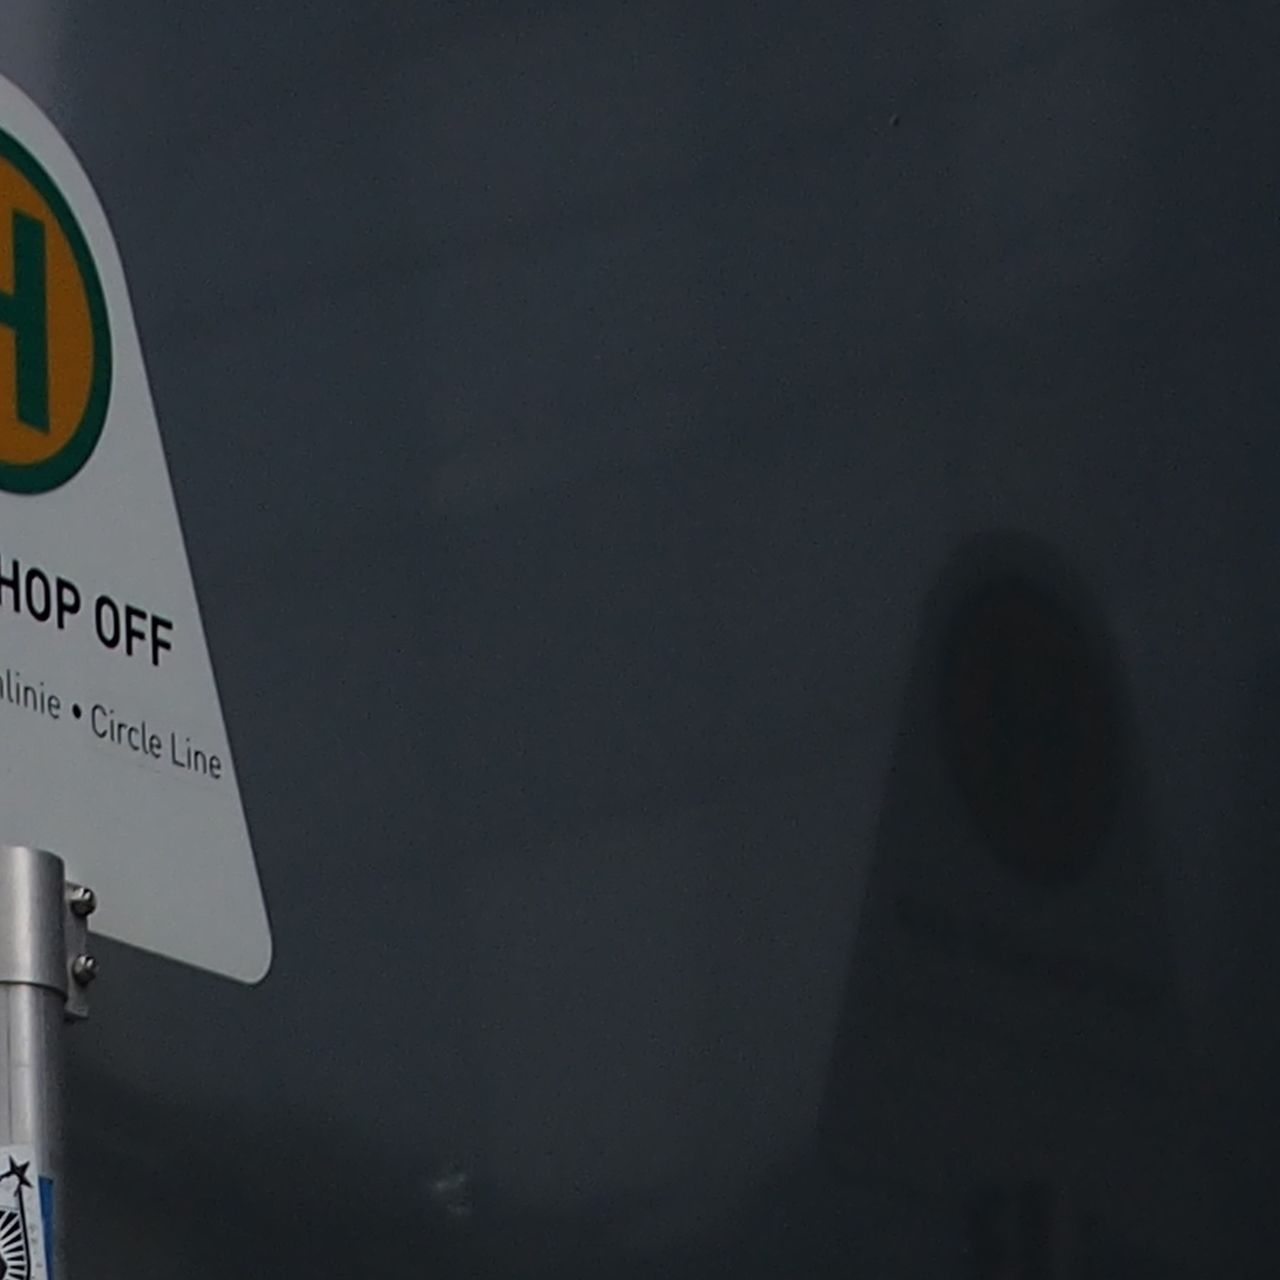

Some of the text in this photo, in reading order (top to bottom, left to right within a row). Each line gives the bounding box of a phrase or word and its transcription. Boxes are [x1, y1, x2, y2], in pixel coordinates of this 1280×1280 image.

[95, 594, 174, 667] OFF
[90, 703, 163, 760] Circle
[169, 730, 222, 781] Line
